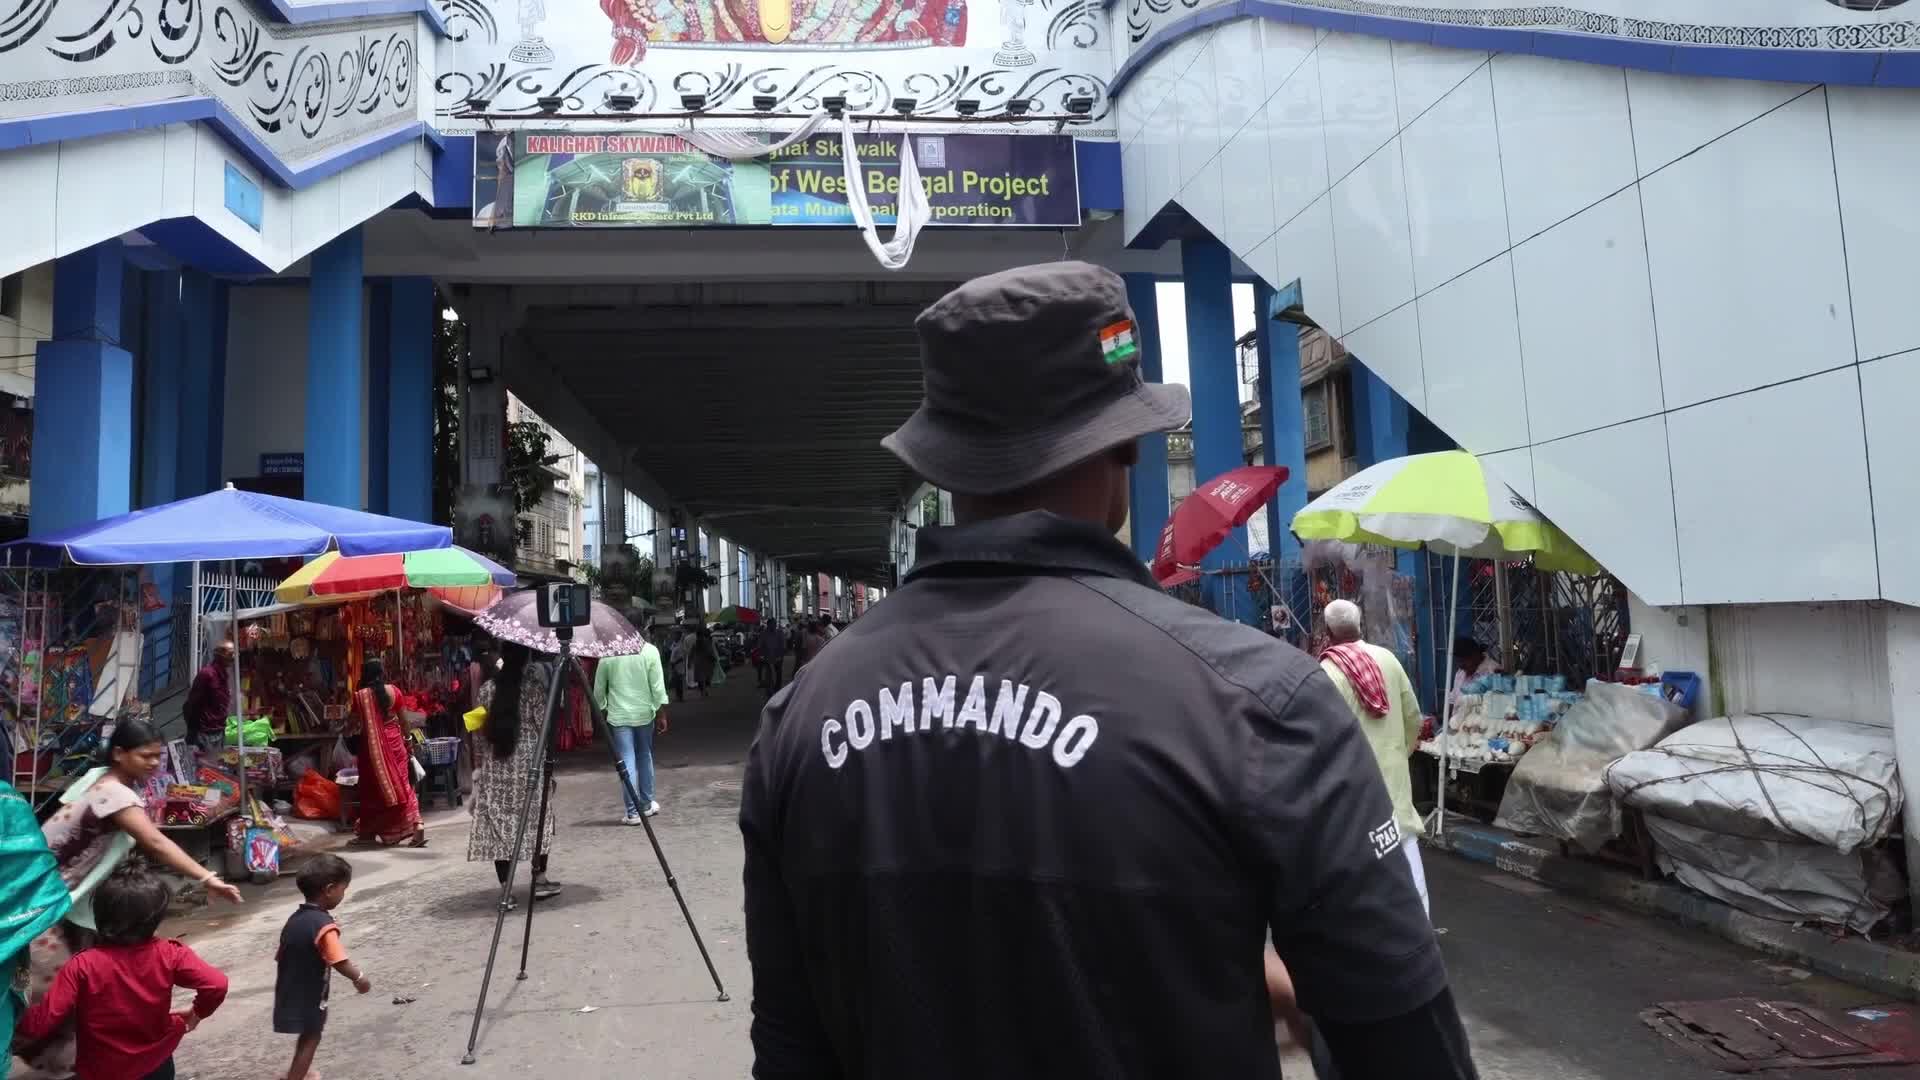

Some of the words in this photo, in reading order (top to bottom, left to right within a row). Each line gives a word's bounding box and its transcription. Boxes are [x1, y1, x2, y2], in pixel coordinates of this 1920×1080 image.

[527, 136, 605, 153] KALIGHAT
[607, 136, 686, 153] SKYWALK
[815, 140, 897, 157] Skwalk
[770, 169, 790, 193] of
[796, 169, 847, 194] Wes
[868, 171, 954, 199] Begal
[962, 171, 1049, 201] Project
[571, 212, 596, 221] RKD
[676, 211, 694, 221] Pvt
[696, 211, 714, 221] Ltd
[806, 202, 897, 217] Munipal
[929, 203, 1013, 219] rporation
[820, 674, 1099, 769] COMMANDO
[1375, 826, 1396, 850] TAC
